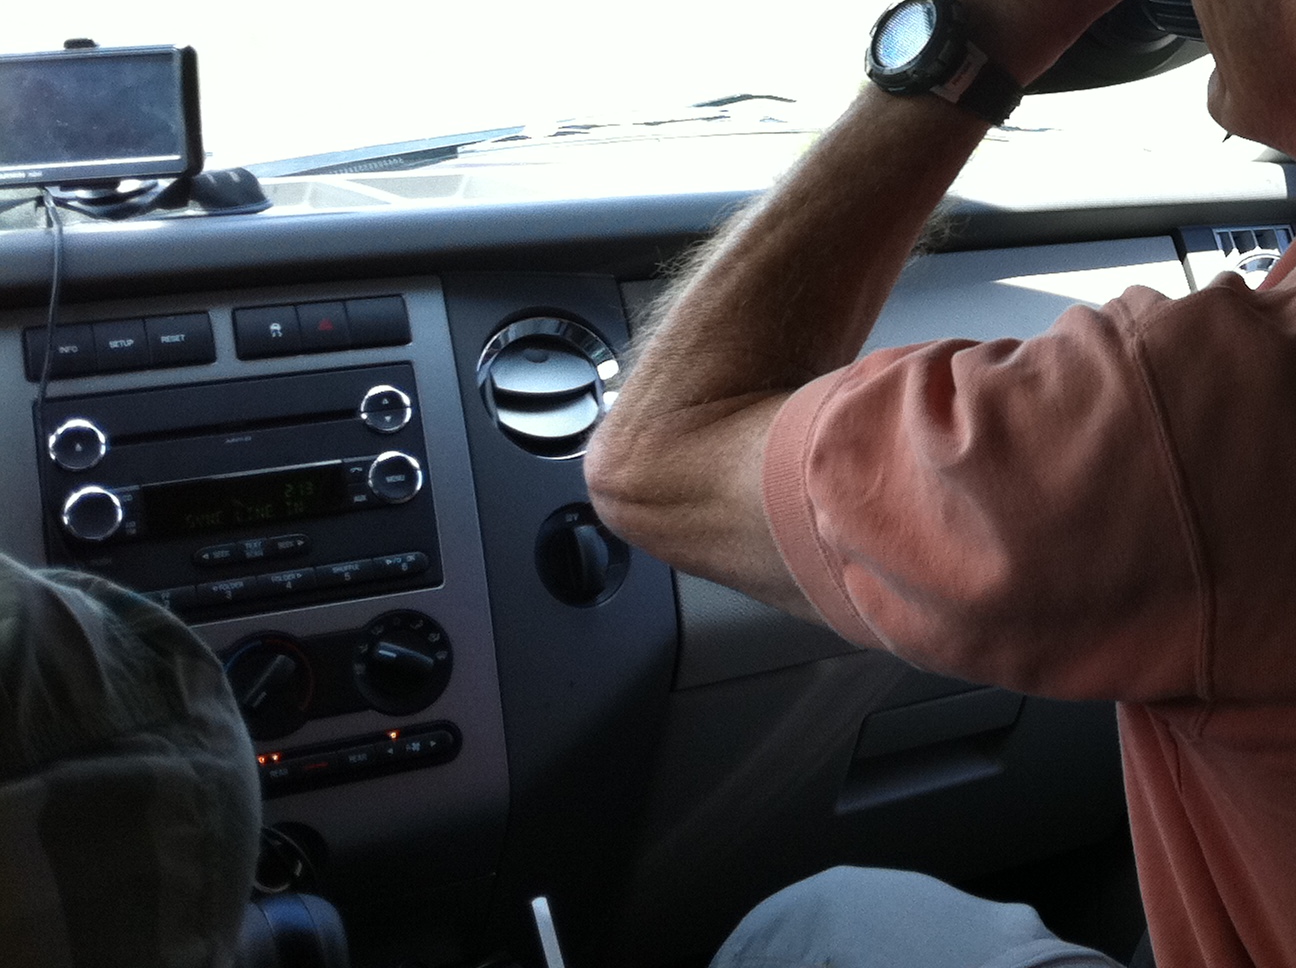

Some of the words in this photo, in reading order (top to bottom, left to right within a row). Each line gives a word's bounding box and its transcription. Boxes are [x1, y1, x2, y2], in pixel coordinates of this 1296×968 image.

[160, 334, 186, 344] RESET
[58, 345, 79, 354] INFO
[108, 339, 134, 350] SETUP
[218, 581, 244, 592] FOLDER
